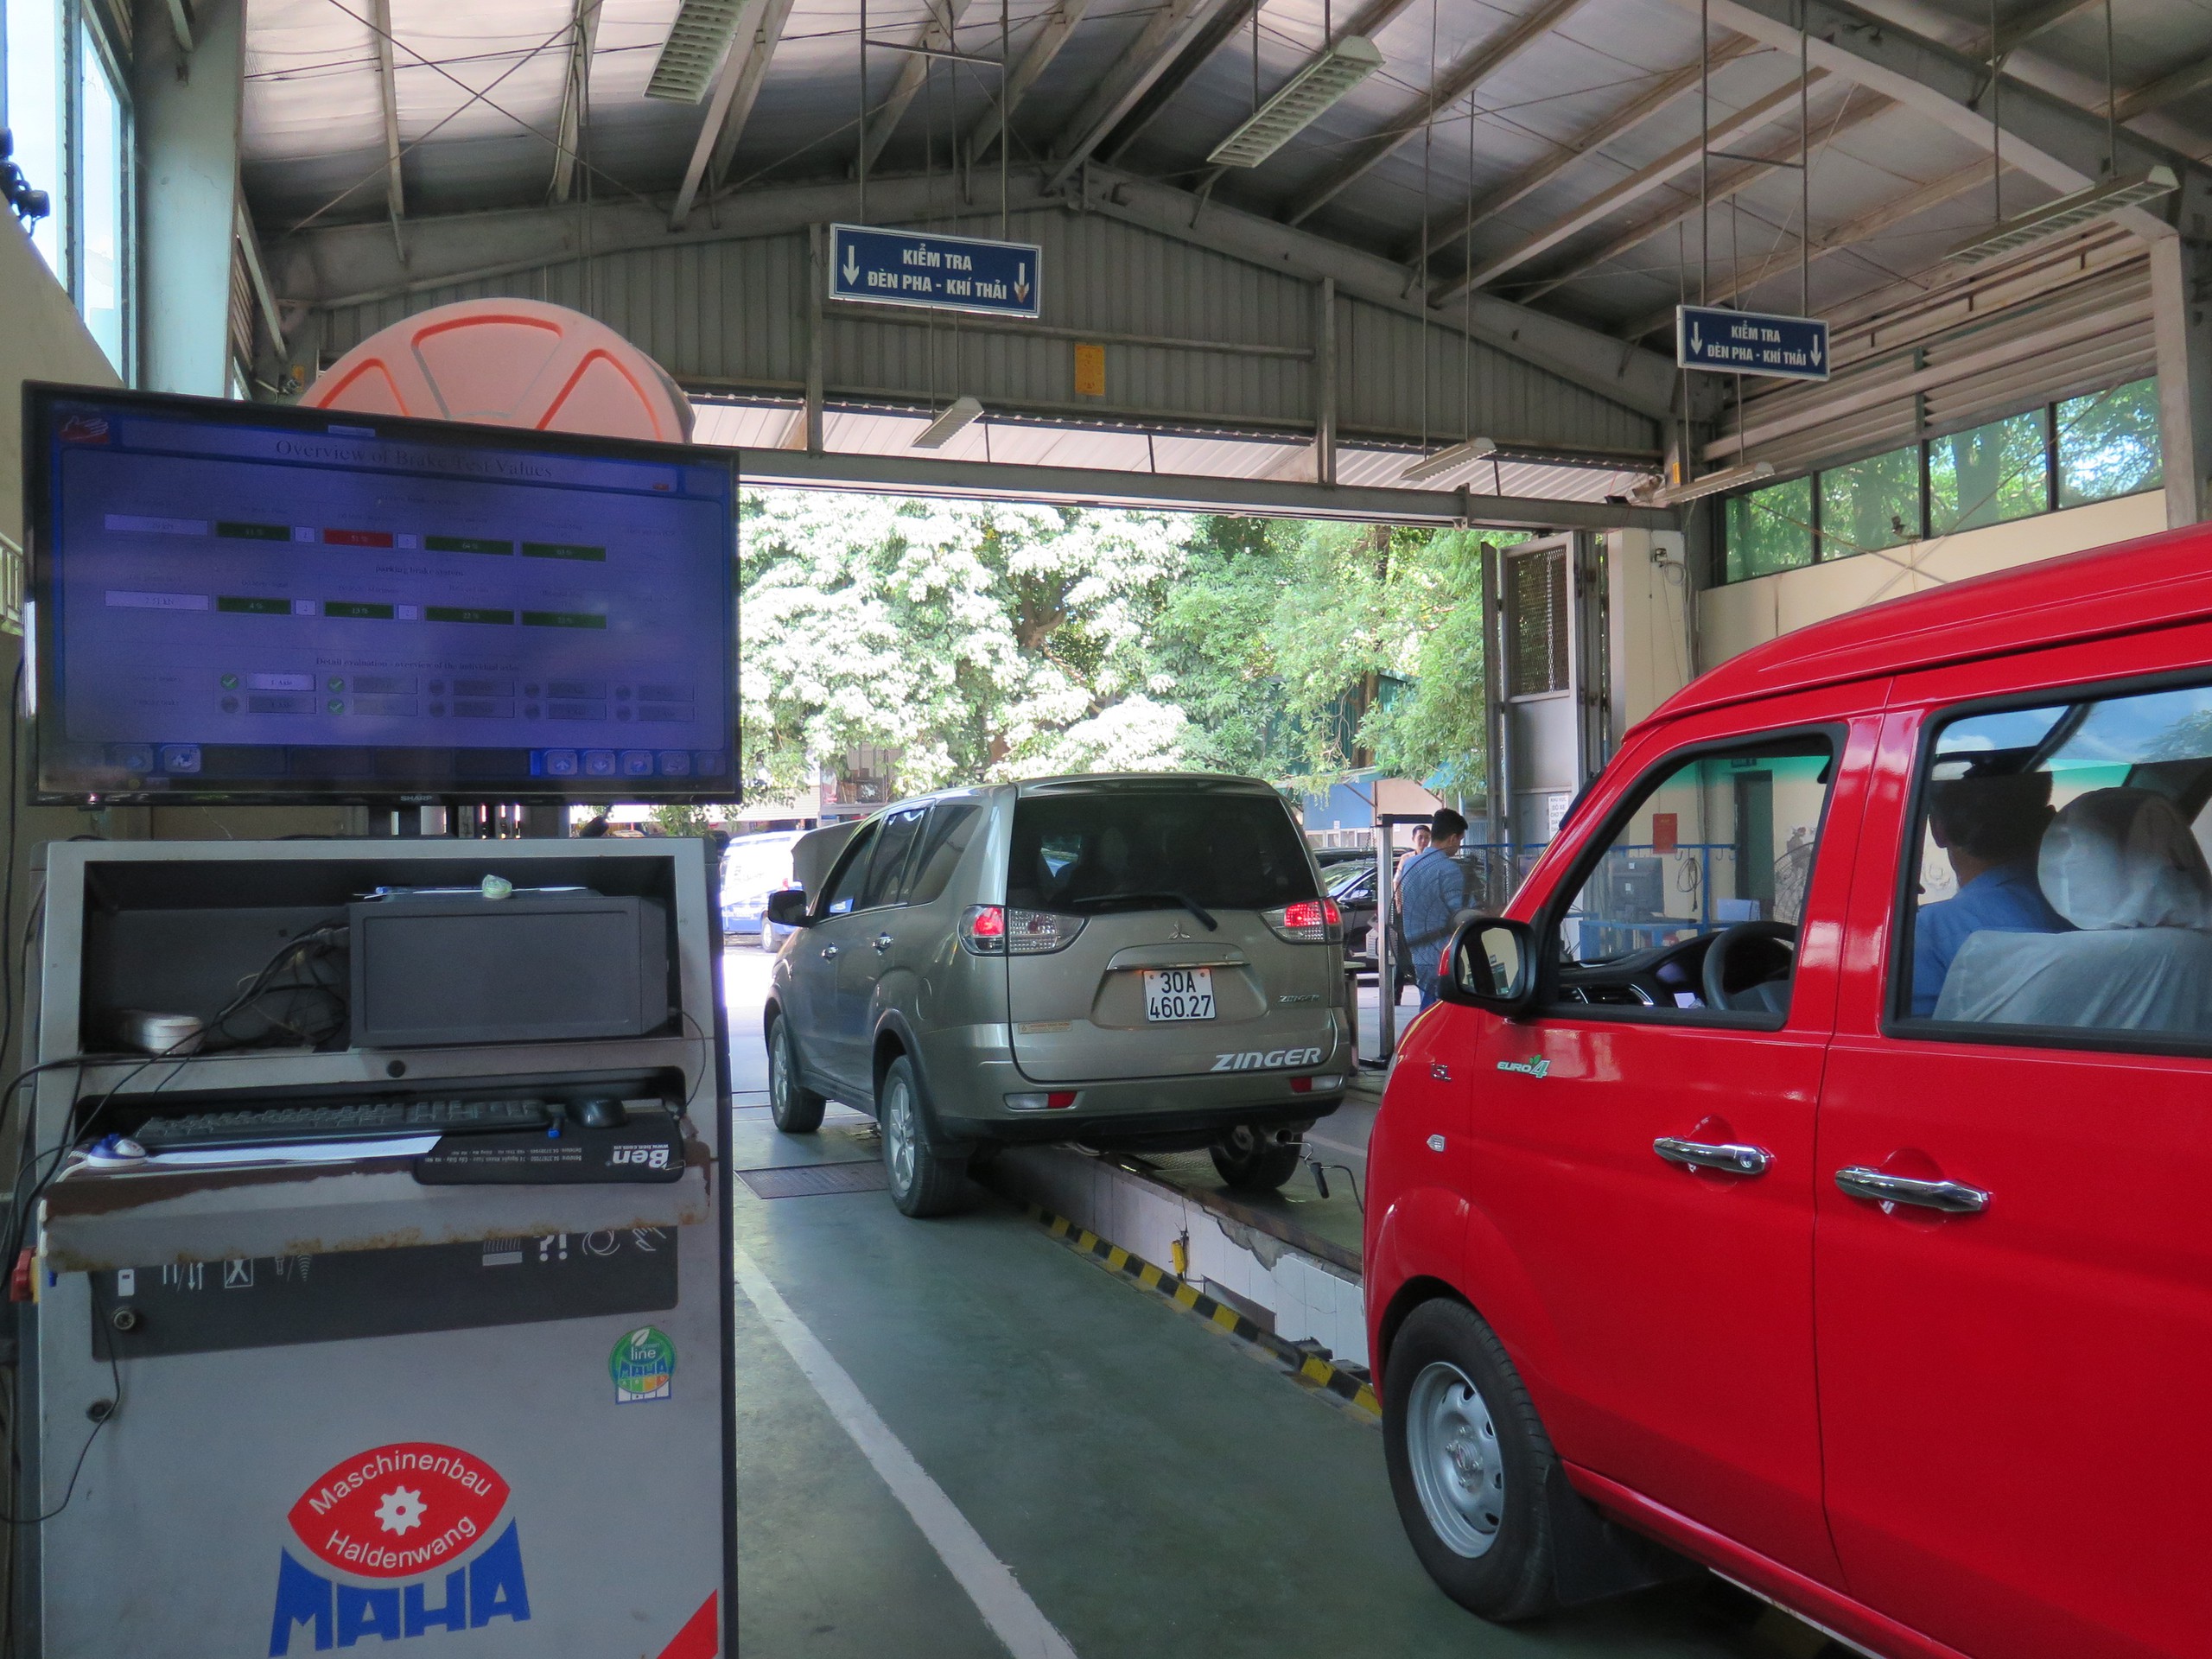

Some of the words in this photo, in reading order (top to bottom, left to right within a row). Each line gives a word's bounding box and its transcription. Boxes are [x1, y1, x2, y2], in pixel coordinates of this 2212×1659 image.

[902, 243, 940, 268] KIỂM
[944, 253, 972, 270] TRA
[868, 269, 898, 289] ĐÈN
[902, 274, 932, 293] PHA
[946, 276, 972, 296] KHÍ
[976, 278, 1007, 300] THẢI
[1731, 320, 1758, 340] KIỂM
[1761, 329, 1781, 343] TRA
[1707, 341, 1729, 359] ĐÈN
[1732, 346, 1753, 361] PHA
[1763, 347, 1781, 364] KHÍ
[1783, 348, 1807, 365] THẢI
[276, 440, 365, 462] Overview
[372, 450, 387, 463] of
[397, 450, 445, 469] Brake
[454, 454, 489, 472] Test
[496, 459, 552, 478] Values
[375, 565, 408, 575] parking
[410, 567, 434, 575] brake
[435, 569, 464, 578] system
[315, 657, 342, 666] Detail
[344, 658, 387, 667] evaluation
[459, 662, 499, 671] individual
[1160, 971, 1196, 994] 30A
[1149, 995, 1211, 1019] 460.27
[1211, 1046, 1321, 1071] ZINGER
[613, 1149, 669, 1168] Ben
[631, 1345, 657, 1360] line
[619, 1356, 669, 1378] MAHA
[308, 1450, 493, 1516] Maschinenbau
[325, 1514, 478, 1569] Haldenwang
[268, 1516, 531, 1658] MAHA
